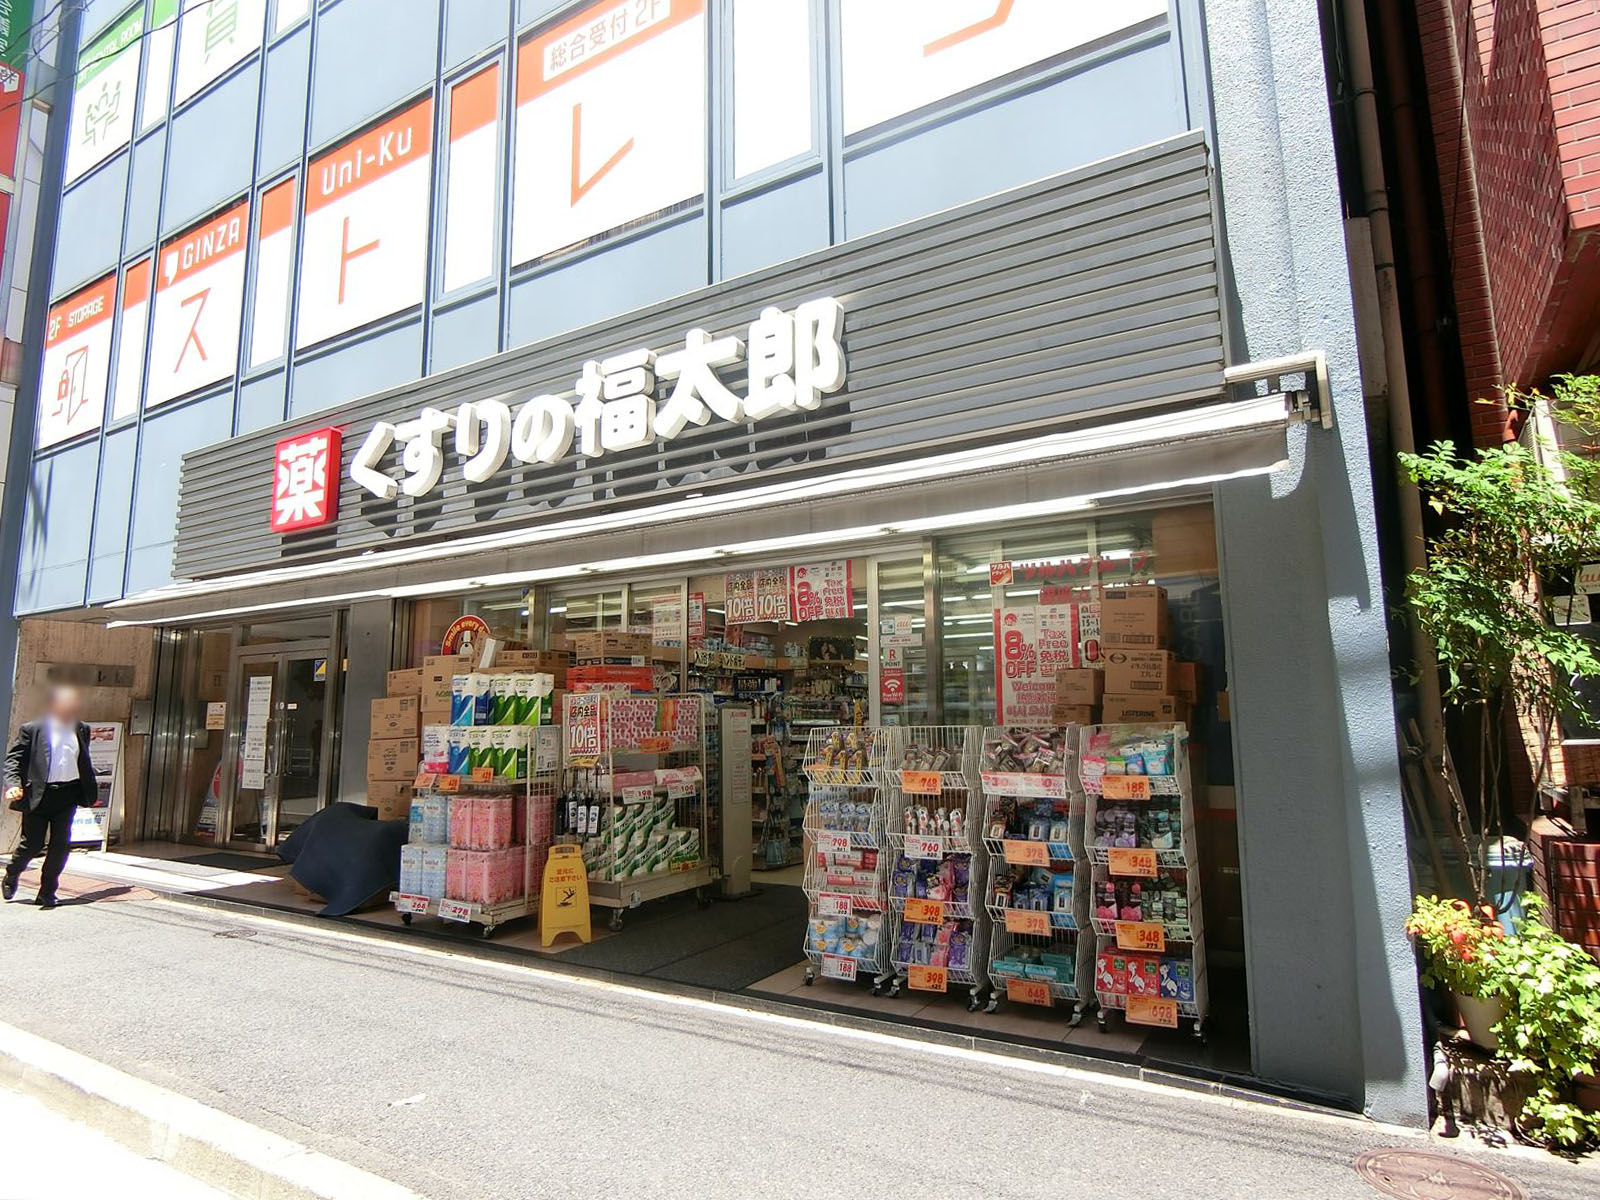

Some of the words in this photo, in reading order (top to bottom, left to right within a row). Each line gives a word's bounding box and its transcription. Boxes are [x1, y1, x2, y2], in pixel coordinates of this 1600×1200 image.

[549, 8, 628, 71] 総合受付
[322, 125, 412, 195] Uni-Ku
[182, 216, 241, 271] GINZA
[48, 316, 62, 341] 2F
[67, 295, 105, 329] STORAGE
[350, 296, 846, 498] くすりの福太郎
[277, 436, 327, 523] 薬
[727, 597, 755, 618] 10倍
[758, 594, 787, 616] 10倍
[799, 606, 823, 620] OFF
[1041, 628, 1067, 639] Tax
[1004, 630, 1037, 661] 8%
[1039, 639, 1068, 649] Free
[1041, 650, 1069, 663] 免税
[1005, 661, 1037, 679] OFF
[570, 725, 597, 748] 10倍
[832, 838, 847, 847] 798
[921, 842, 939, 852] 760
[452, 906, 470, 916] 278
[835, 901, 848, 910] 188
[923, 905, 940, 916] 398
[1139, 930, 1159, 942] 348
[839, 963, 852, 972] 188
[926, 972, 943, 984] 398
[1151, 1005, 1172, 1017] 698
